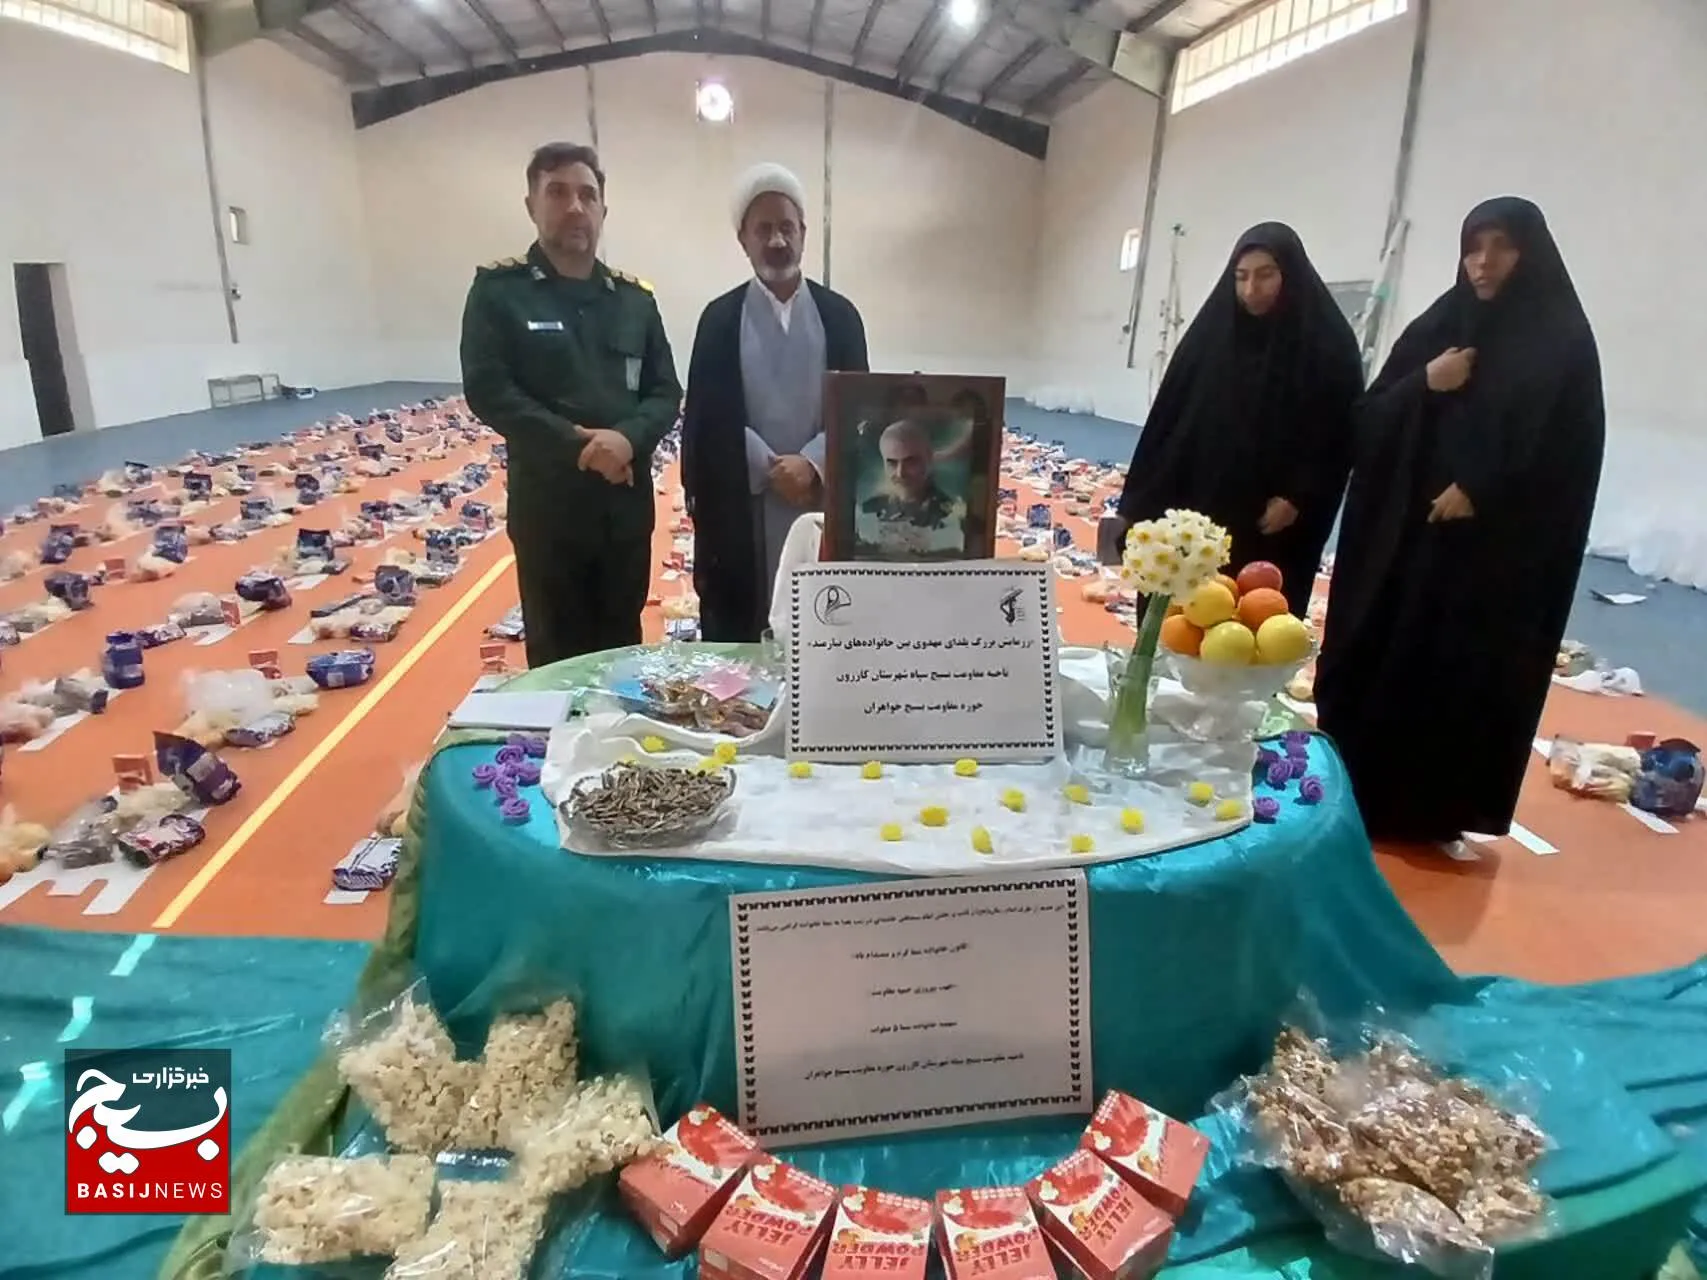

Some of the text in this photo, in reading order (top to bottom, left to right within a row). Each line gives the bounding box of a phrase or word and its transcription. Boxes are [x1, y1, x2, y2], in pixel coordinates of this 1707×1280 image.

[723, 1220, 793, 1245] JELLY
[725, 1205, 812, 1236] POWDER
[832, 1240, 925, 1256] POWDER
[971, 1244, 1031, 1276] JELLY
[838, 1255, 911, 1270] JELLY
